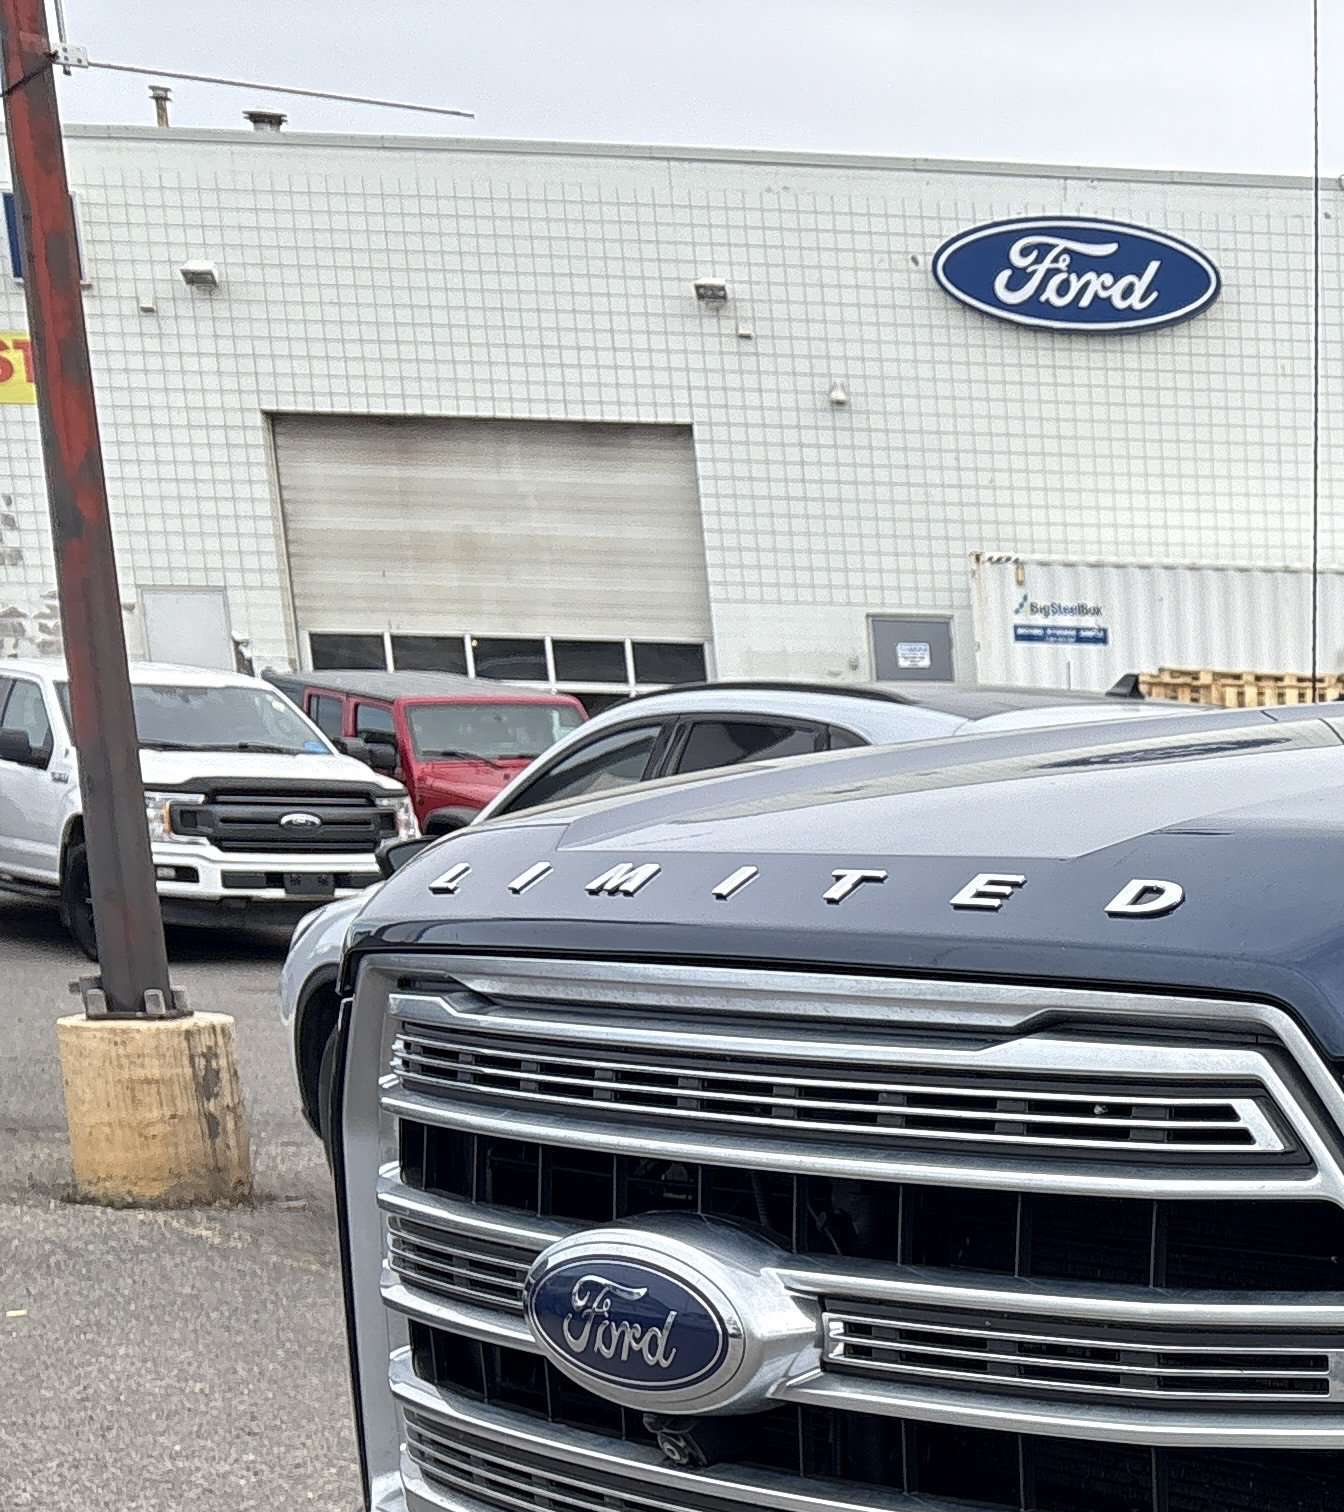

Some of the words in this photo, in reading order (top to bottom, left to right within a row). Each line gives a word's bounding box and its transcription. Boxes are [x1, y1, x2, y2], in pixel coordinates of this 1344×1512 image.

[993, 236, 1161, 311] Ford
[428, 861, 1187, 919] LIMITED
[562, 1274, 679, 1369] Ford
